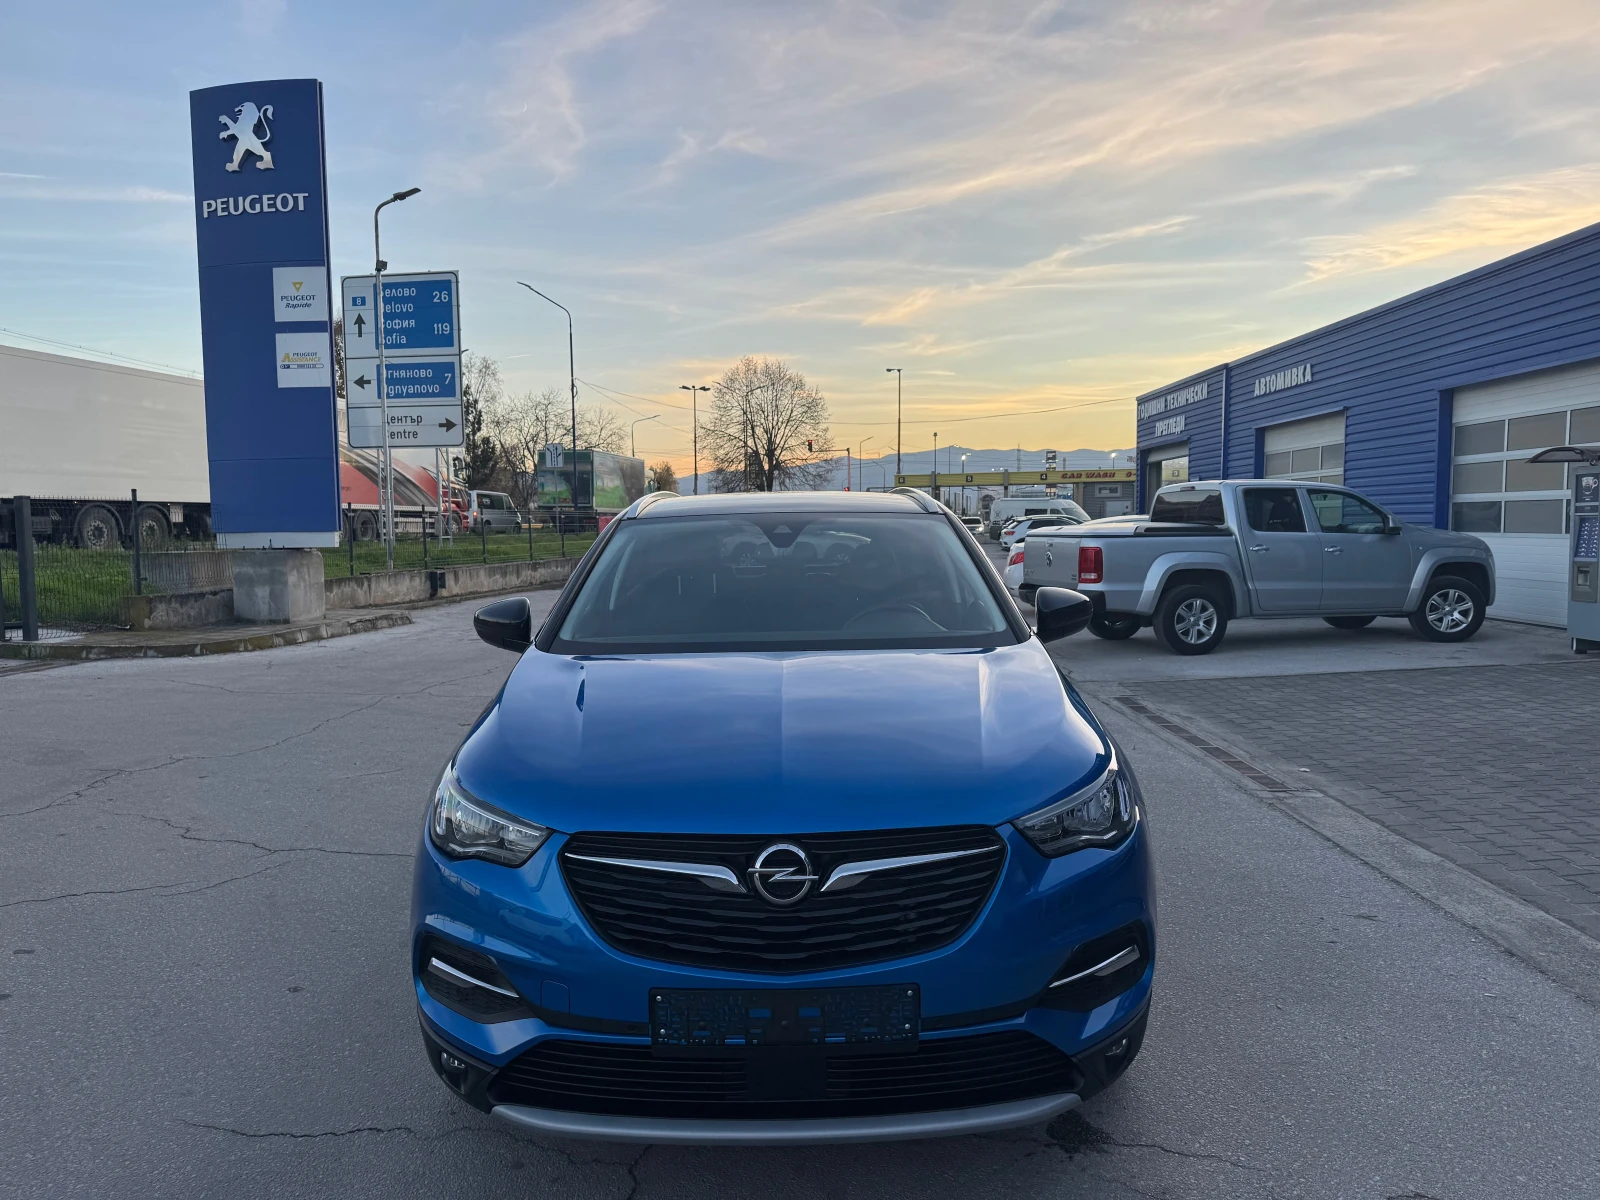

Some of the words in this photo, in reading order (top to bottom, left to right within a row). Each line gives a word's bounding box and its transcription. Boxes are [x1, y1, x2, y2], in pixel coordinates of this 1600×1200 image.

[203, 193, 309, 218] PEUGEOT
[382, 287, 416, 297] елово
[432, 291, 449, 303] 26
[356, 297, 362, 305] 8
[382, 301, 414, 313] elovo
[383, 318, 415, 329] офия
[433, 322, 450, 335] 119
[281, 353, 322, 363] ASSISTANCE
[384, 369, 433, 379] гняново
[444, 373, 452, 385] 7
[1254, 363, 1312, 397] АВТОМИВКА
[384, 384, 440, 397] gnyanovo
[1138, 396, 1165, 420] ГОДИШНИ
[1166, 381, 1208, 411] ТЕХНИЧЕСКИ
[1155, 414, 1186, 437] ПРЕГЛЕДИ
[387, 428, 419, 439] entre
[1085, 471, 1116, 479] WASH
